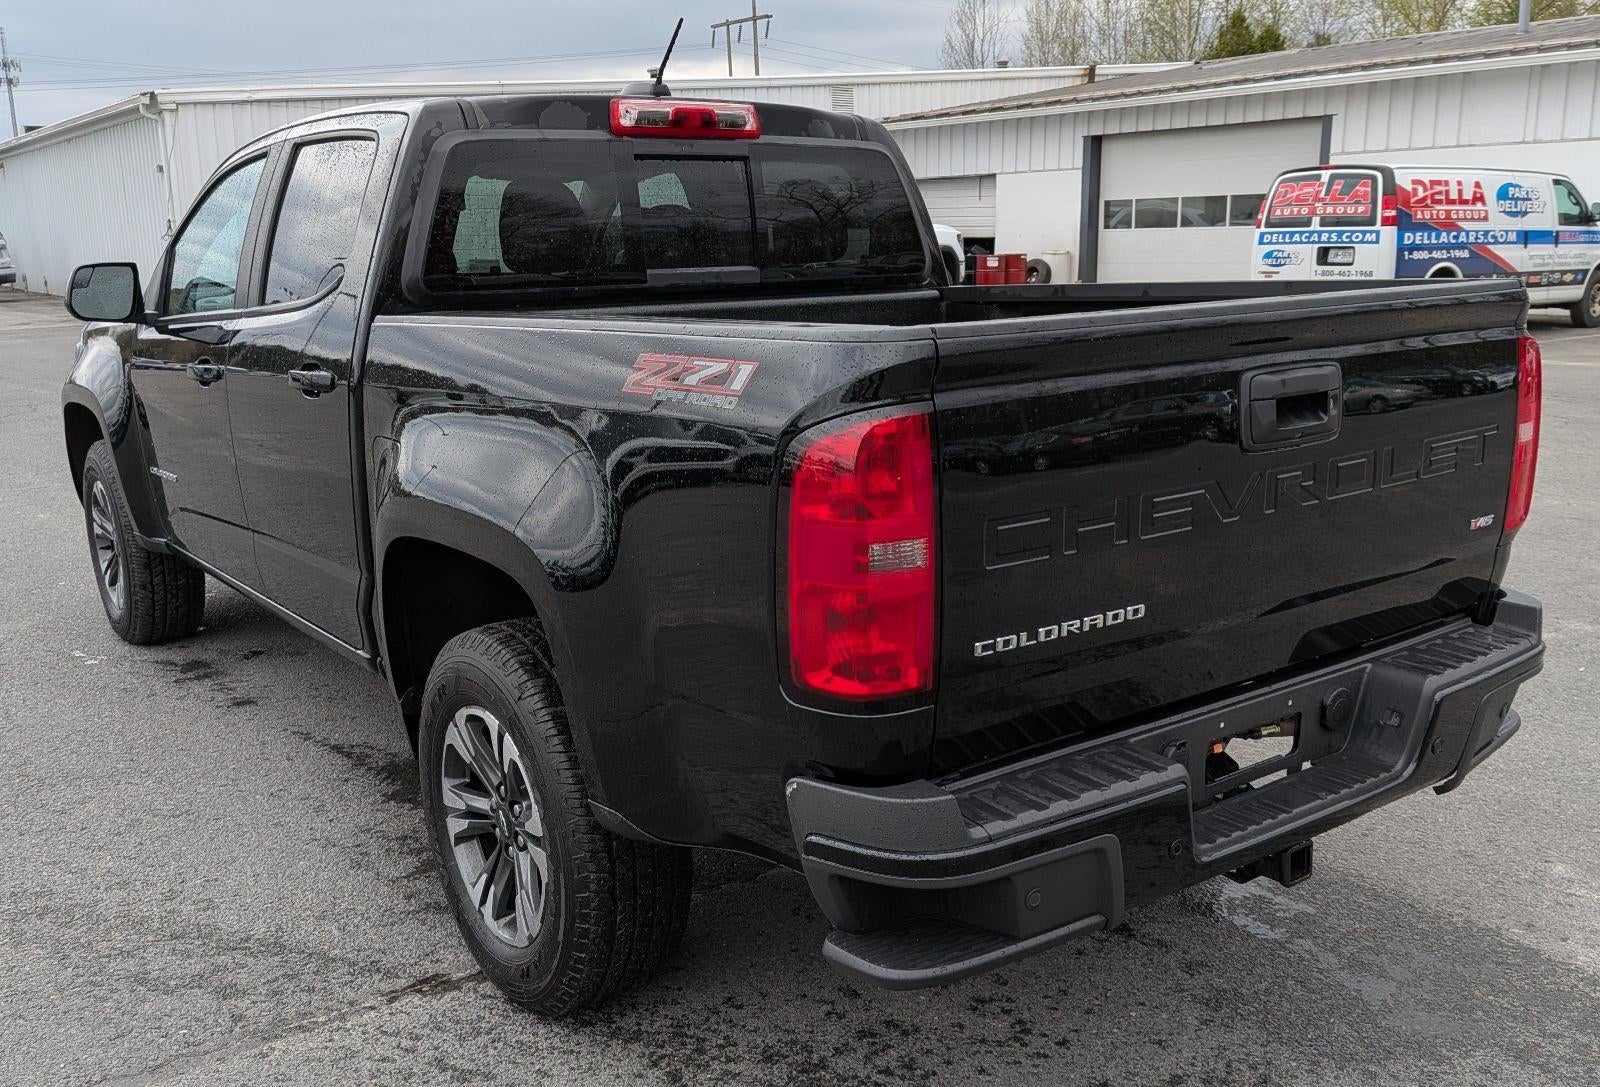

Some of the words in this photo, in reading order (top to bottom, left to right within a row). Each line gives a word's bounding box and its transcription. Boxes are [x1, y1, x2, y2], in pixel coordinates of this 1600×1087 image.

[1272, 180, 1372, 206] DELLA
[1410, 178, 1487, 206] DELLA
[1508, 187, 1540, 200] PARTS
[1275, 207, 1309, 216] AUTO
[1316, 205, 1366, 214] GROUP
[1499, 200, 1546, 213] DELIVERY
[1416, 210, 1446, 219] AUTO
[1450, 210, 1487, 219] GROUP
[1263, 232, 1377, 243] DELLACARS.COM
[1403, 231, 1518, 245] DELLACARS.COM
[1403, 250, 1470, 260] 1-800-462-1968
[1314, 270, 1374, 278] 1-800-462-1968
[622, 353, 760, 396] Z71
[983, 424, 1499, 570] CHEVROLET
[974, 604, 1146, 657] COLORADO
